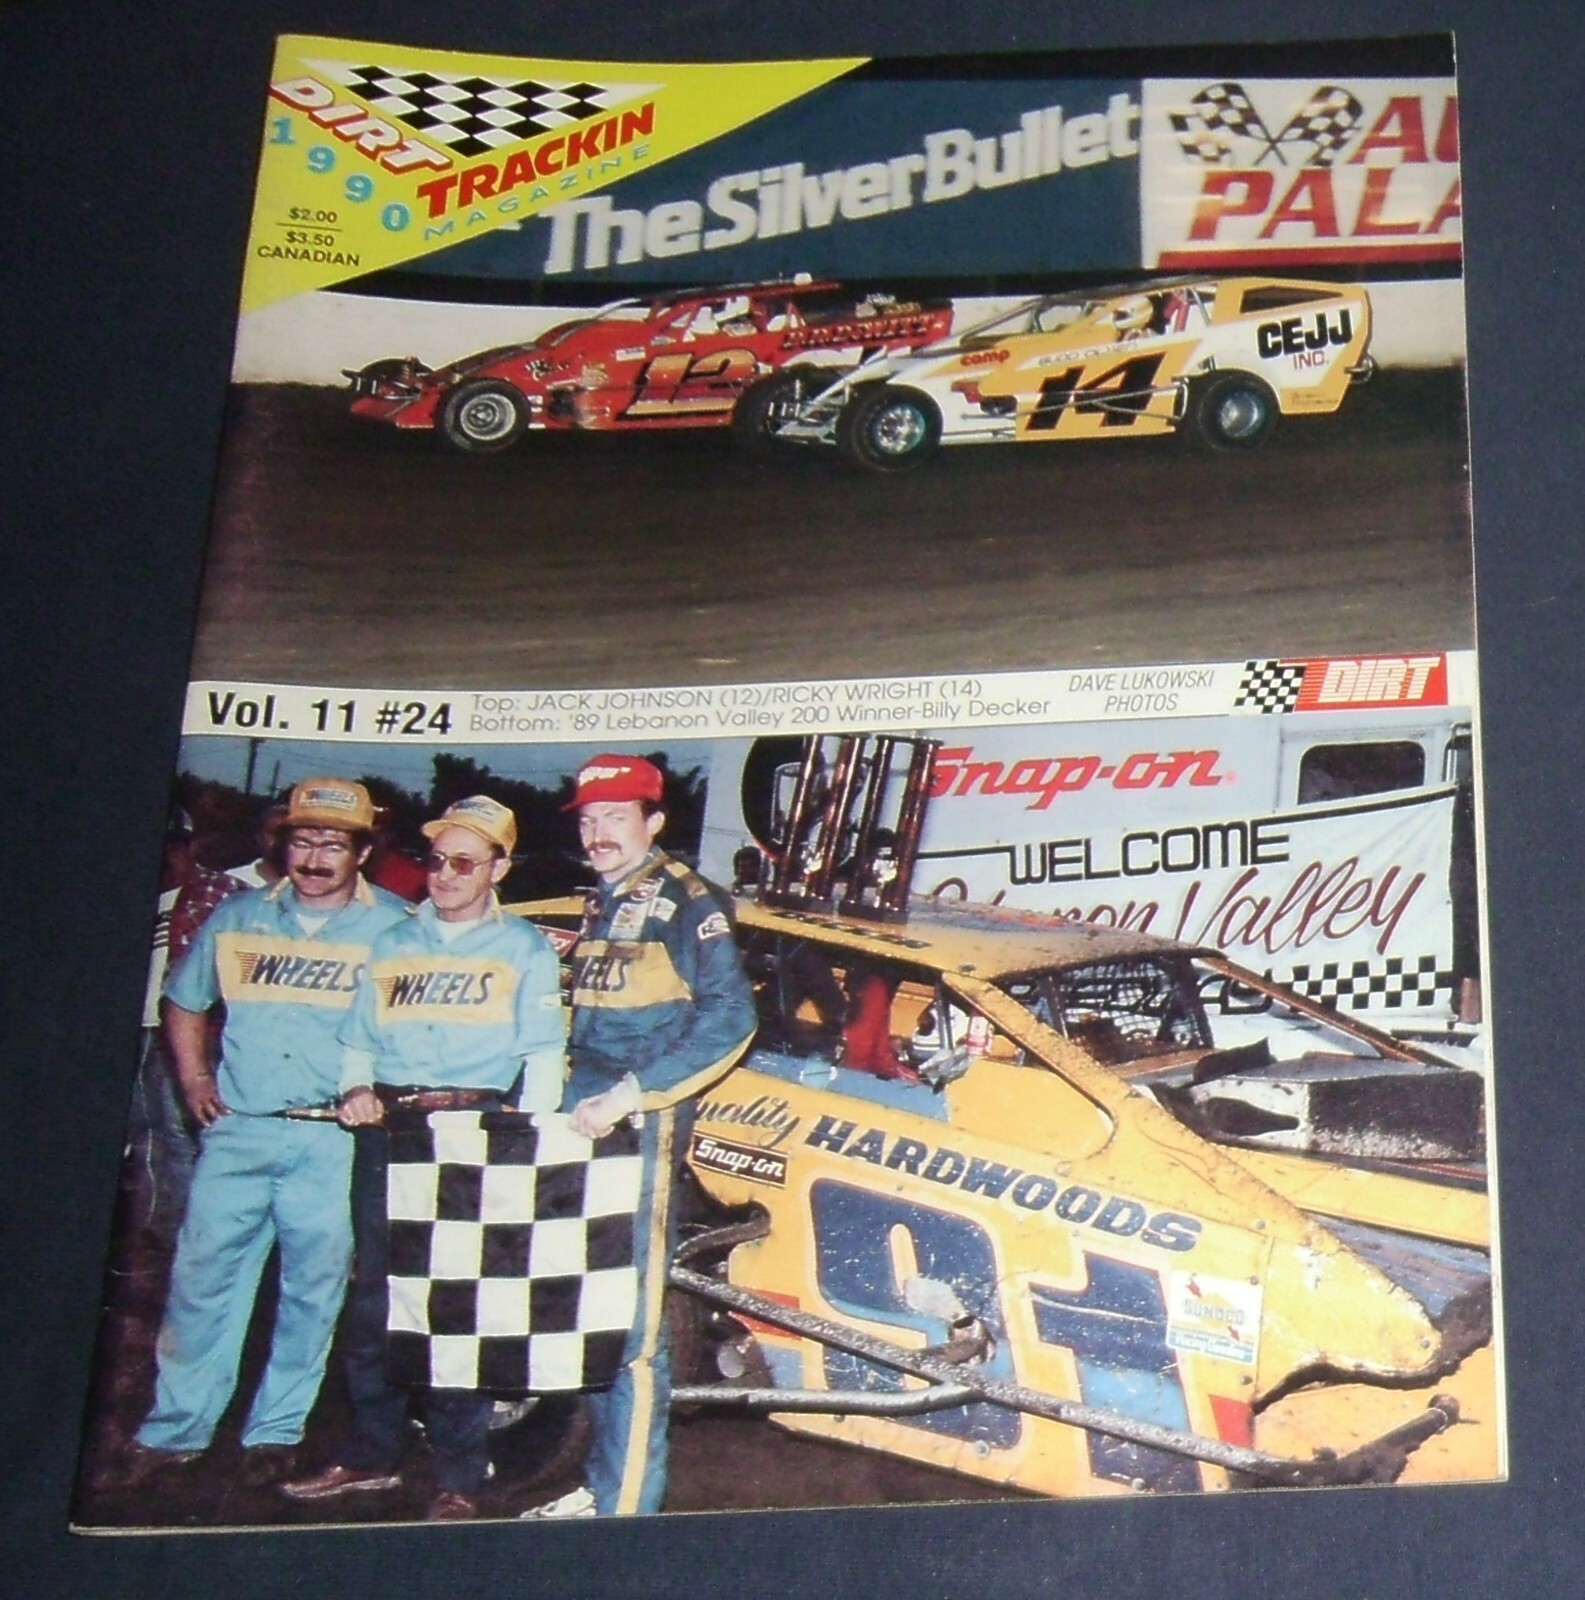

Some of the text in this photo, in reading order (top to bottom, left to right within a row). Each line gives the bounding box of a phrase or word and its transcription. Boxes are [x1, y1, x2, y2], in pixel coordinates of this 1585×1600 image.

[269, 76, 454, 175] DIRT
[416, 101, 656, 219] TRACKIN
[423, 142, 652, 242] MAGAZINE
[288, 207, 338, 224] $2.00
[256, 245, 361, 267] CANADIAN
[285, 231, 335, 247] $3.50
[1257, 308, 1353, 360] CEJJ
[615, 348, 757, 421] 12
[1024, 352, 1167, 431] 14
[473, 694, 520, 713] Top:
[527, 693, 592, 711] JACK
[597, 689, 712, 710] JOHNSON
[845, 681, 934, 701] WRIGHT
[939, 679, 983, 699] (14)
[1068, 669, 1216, 693] DAVE LUKOWSKI
[1317, 656, 1441, 704] DIRT
[208, 691, 453, 735] Vol. 11 #24
[470, 698, 1050, 732] Bottom: '89 Lebanon Valley 200 Winner-Billy Decker
[1104, 693, 1178, 713] PHOTOS
[1007, 819, 1290, 886] WELCOME
[250, 953, 364, 993] WHEELS
[389, 971, 493, 1008] WHEELS
[695, 1138, 785, 1177] Snap-on
[695, 1095, 1203, 1252] uality HARDWOODS
